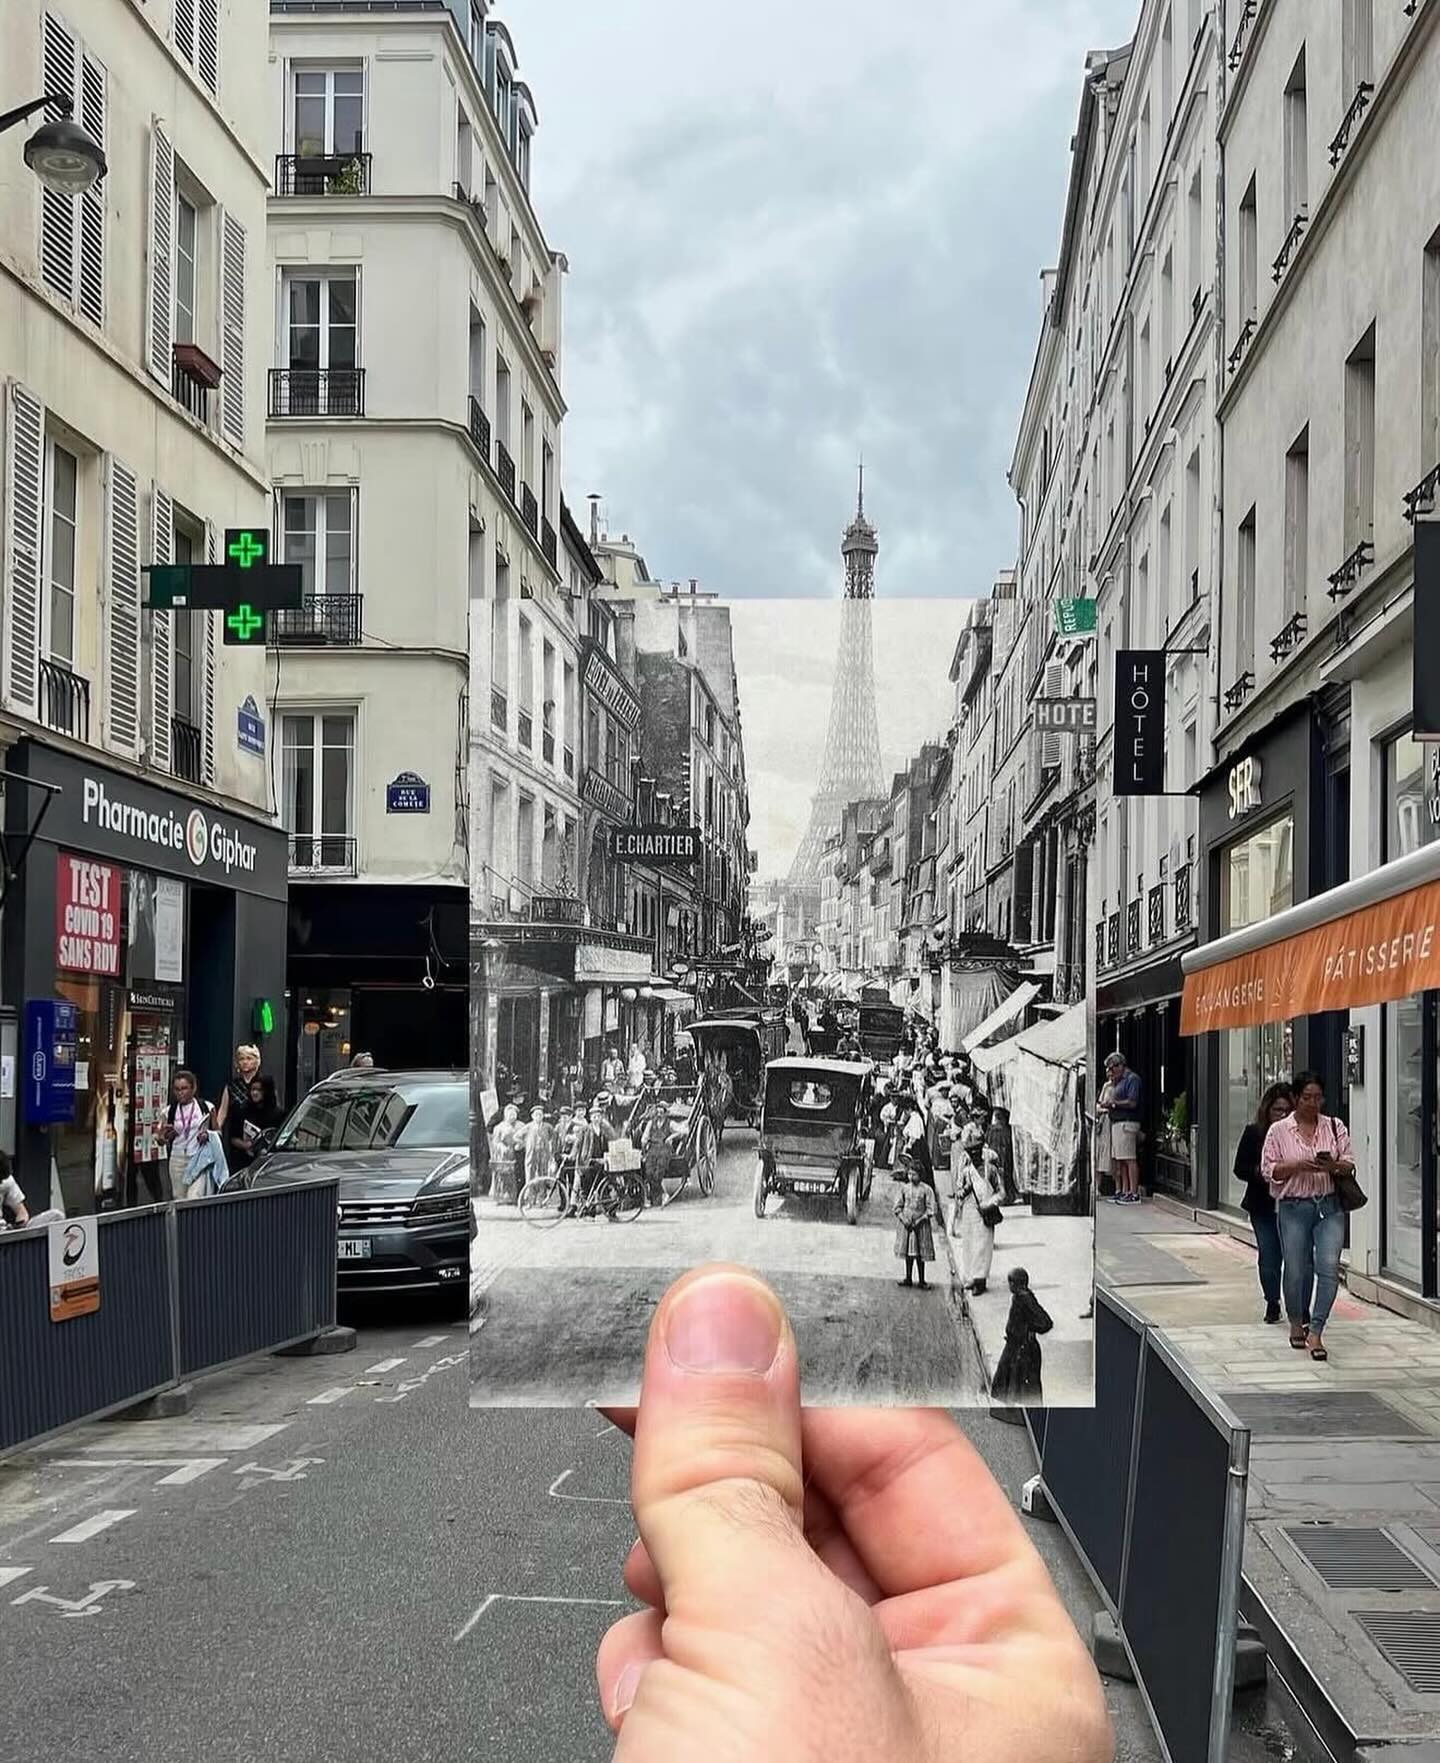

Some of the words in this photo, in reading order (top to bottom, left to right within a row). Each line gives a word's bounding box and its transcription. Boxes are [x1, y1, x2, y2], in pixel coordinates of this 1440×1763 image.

[1131, 664, 1149, 781] HÔTEL
[1228, 756, 1259, 819] SFR
[83, 777, 184, 849] Pharmacie
[211, 823, 257, 874] Giphar
[69, 858, 111, 910] TEST
[65, 904, 99, 938] COVID
[101, 912, 113, 940] 19
[59, 935, 92, 969] SANS
[93, 941, 117, 972] RDV
